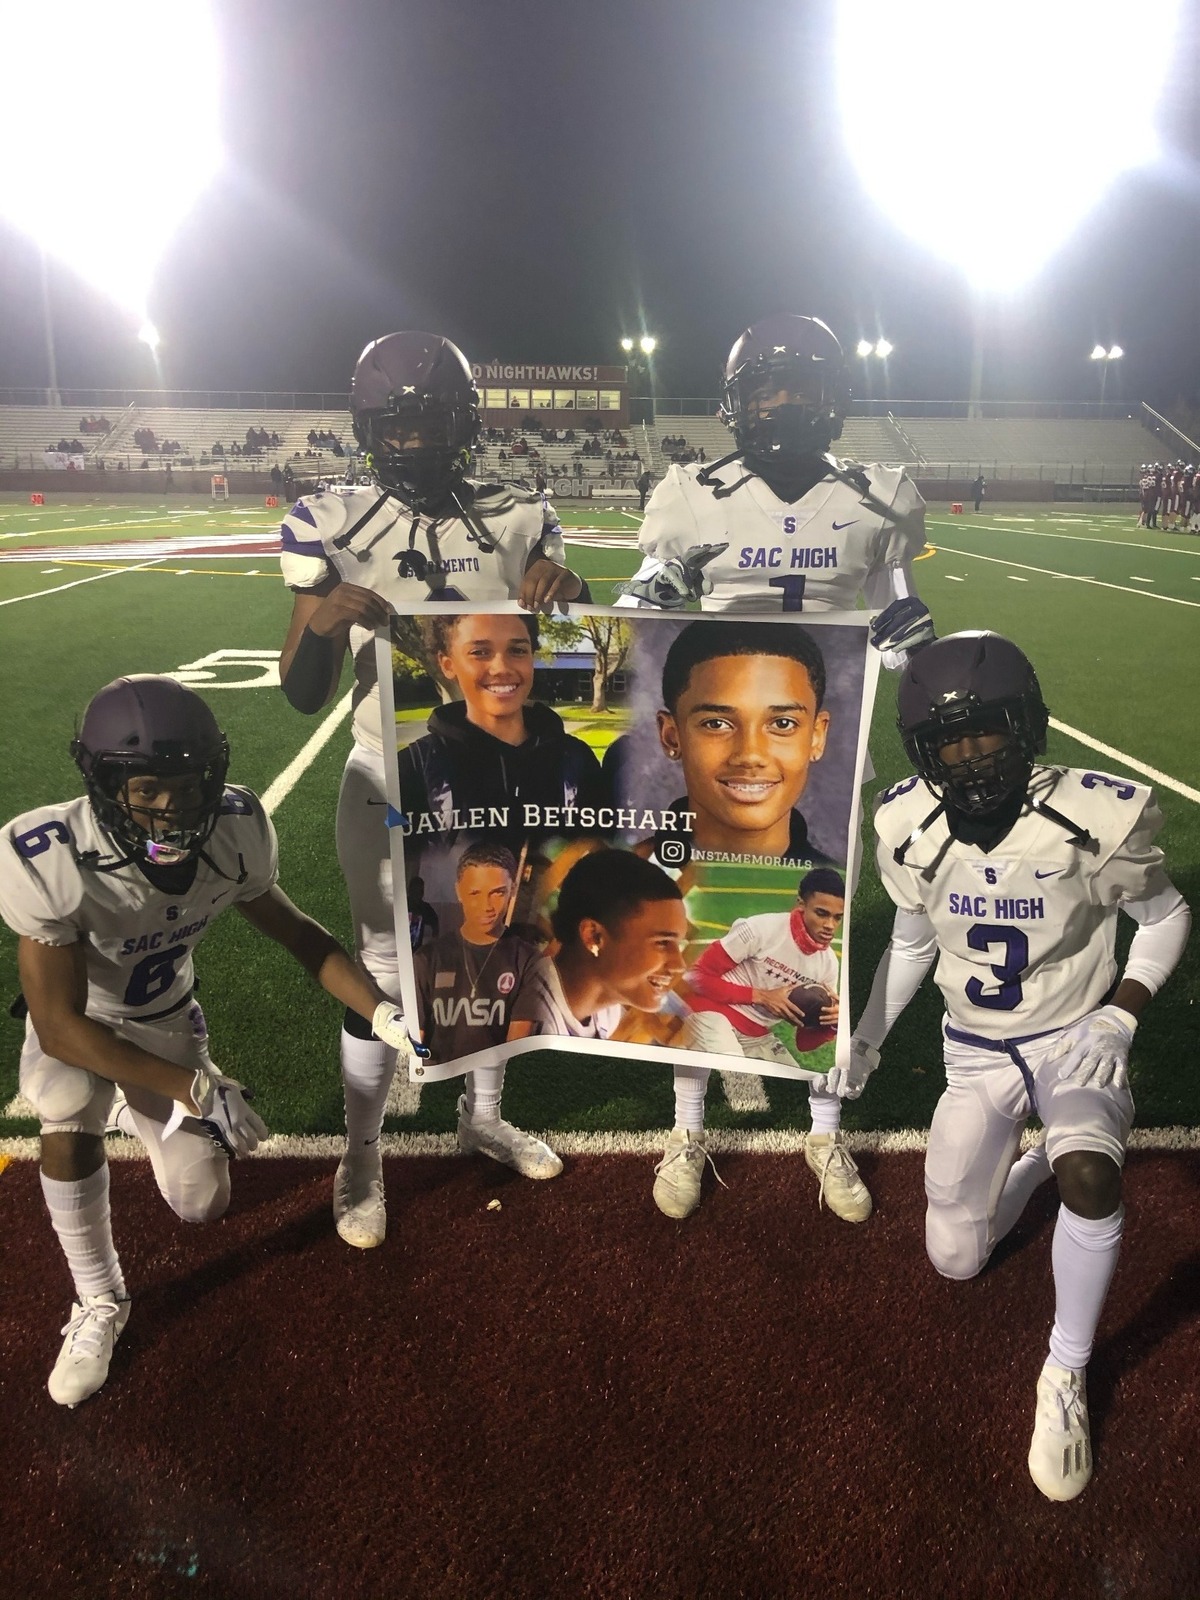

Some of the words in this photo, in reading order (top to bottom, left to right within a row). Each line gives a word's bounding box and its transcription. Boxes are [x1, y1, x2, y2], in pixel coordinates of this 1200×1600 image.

[472, 365, 482, 379] O
[485, 365, 598, 381] NIGHTHAWKS!
[784, 516, 796, 534] S
[738, 547, 782, 568] SAC
[790, 547, 838, 568] HIGH
[769, 574, 806, 612] 1
[401, 806, 509, 837] JAYLEN
[523, 803, 697, 832] BETSCHART
[690, 848, 813, 870] INSTAMEMORIALS
[984, 867, 997, 884] S
[166, 905, 179, 921] S
[950, 892, 987, 917] SAC
[995, 897, 1044, 919] HIGH
[121, 931, 164, 955] SAC
[168, 914, 209, 944] HIGH
[124, 943, 188, 1007] 6
[965, 923, 1029, 1010] 3
[432, 997, 506, 1027] NASA
